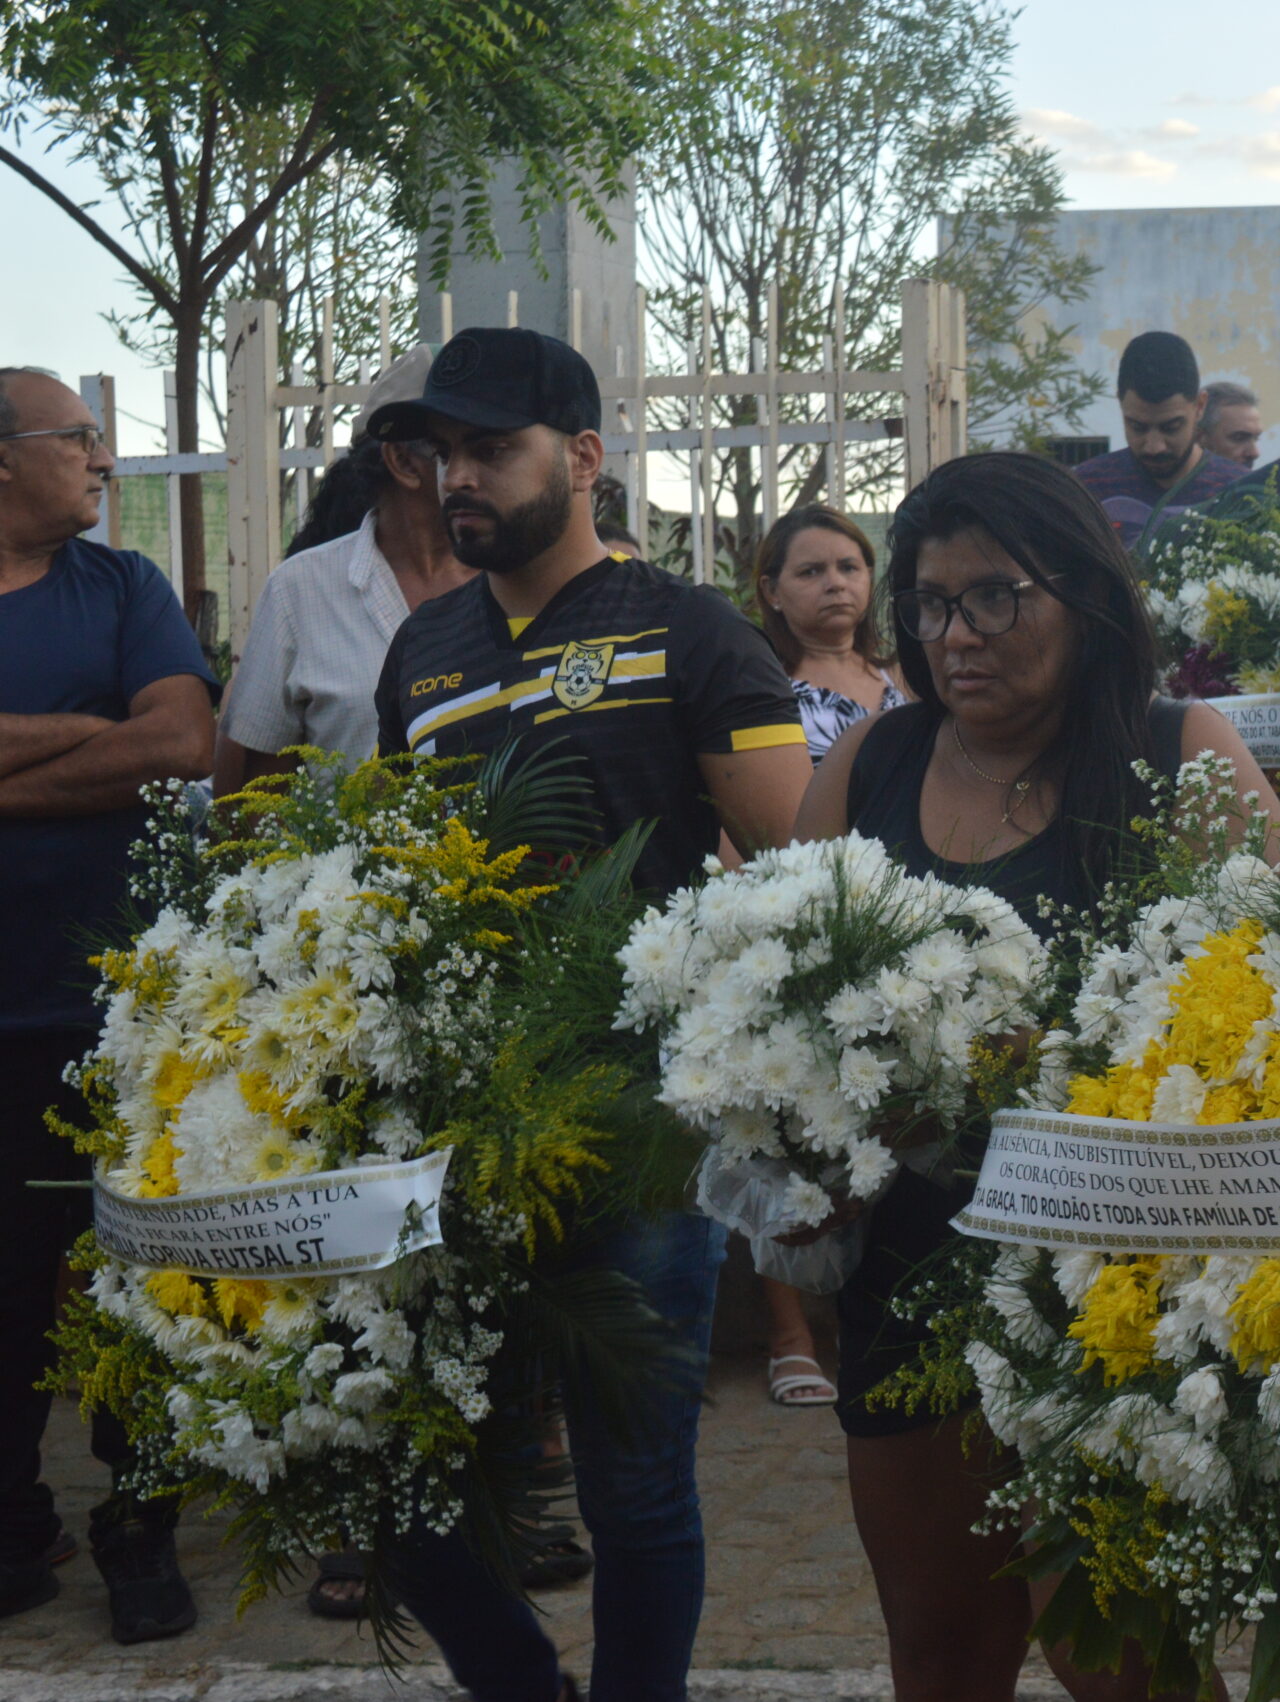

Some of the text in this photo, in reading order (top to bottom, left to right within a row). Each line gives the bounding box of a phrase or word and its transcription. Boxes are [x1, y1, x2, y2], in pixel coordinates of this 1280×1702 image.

[1268, 707, 1277, 723] O
[999, 1132, 1051, 1159] AUSÊNCIA,
[1053, 1141, 1196, 1172] INSUBISTITUÍVEL,
[1000, 1161, 1014, 1178] OS
[1016, 1163, 1086, 1190] CORAÇÕES
[1090, 1173, 1125, 1192] DOS
[1128, 1177, 1169, 1197] QUE
[1171, 1179, 1213, 1195] LHE
[230, 1196, 279, 1218] MAS
[287, 1193, 302, 1209] A
[307, 1184, 359, 1205] TUA
[986, 1188, 1017, 1216] GRAÇA,
[1021, 1194, 1038, 1215] TIO
[1041, 1196, 1090, 1222] ROLDÃO
[1093, 1203, 1102, 1222] E
[1102, 1204, 1147, 1225] TODA
[1147, 1206, 1182, 1226] SUA
[1182, 1201, 1251, 1226] FAMÍLIA
[1252, 1206, 1278, 1227] DE
[145, 1212, 331, 1243] FICARÁ ENTRE NÓS"
[140, 1243, 213, 1269] CORUJA
[210, 1243, 294, 1269] FUTSAL
[296, 1237, 324, 1263] ST
